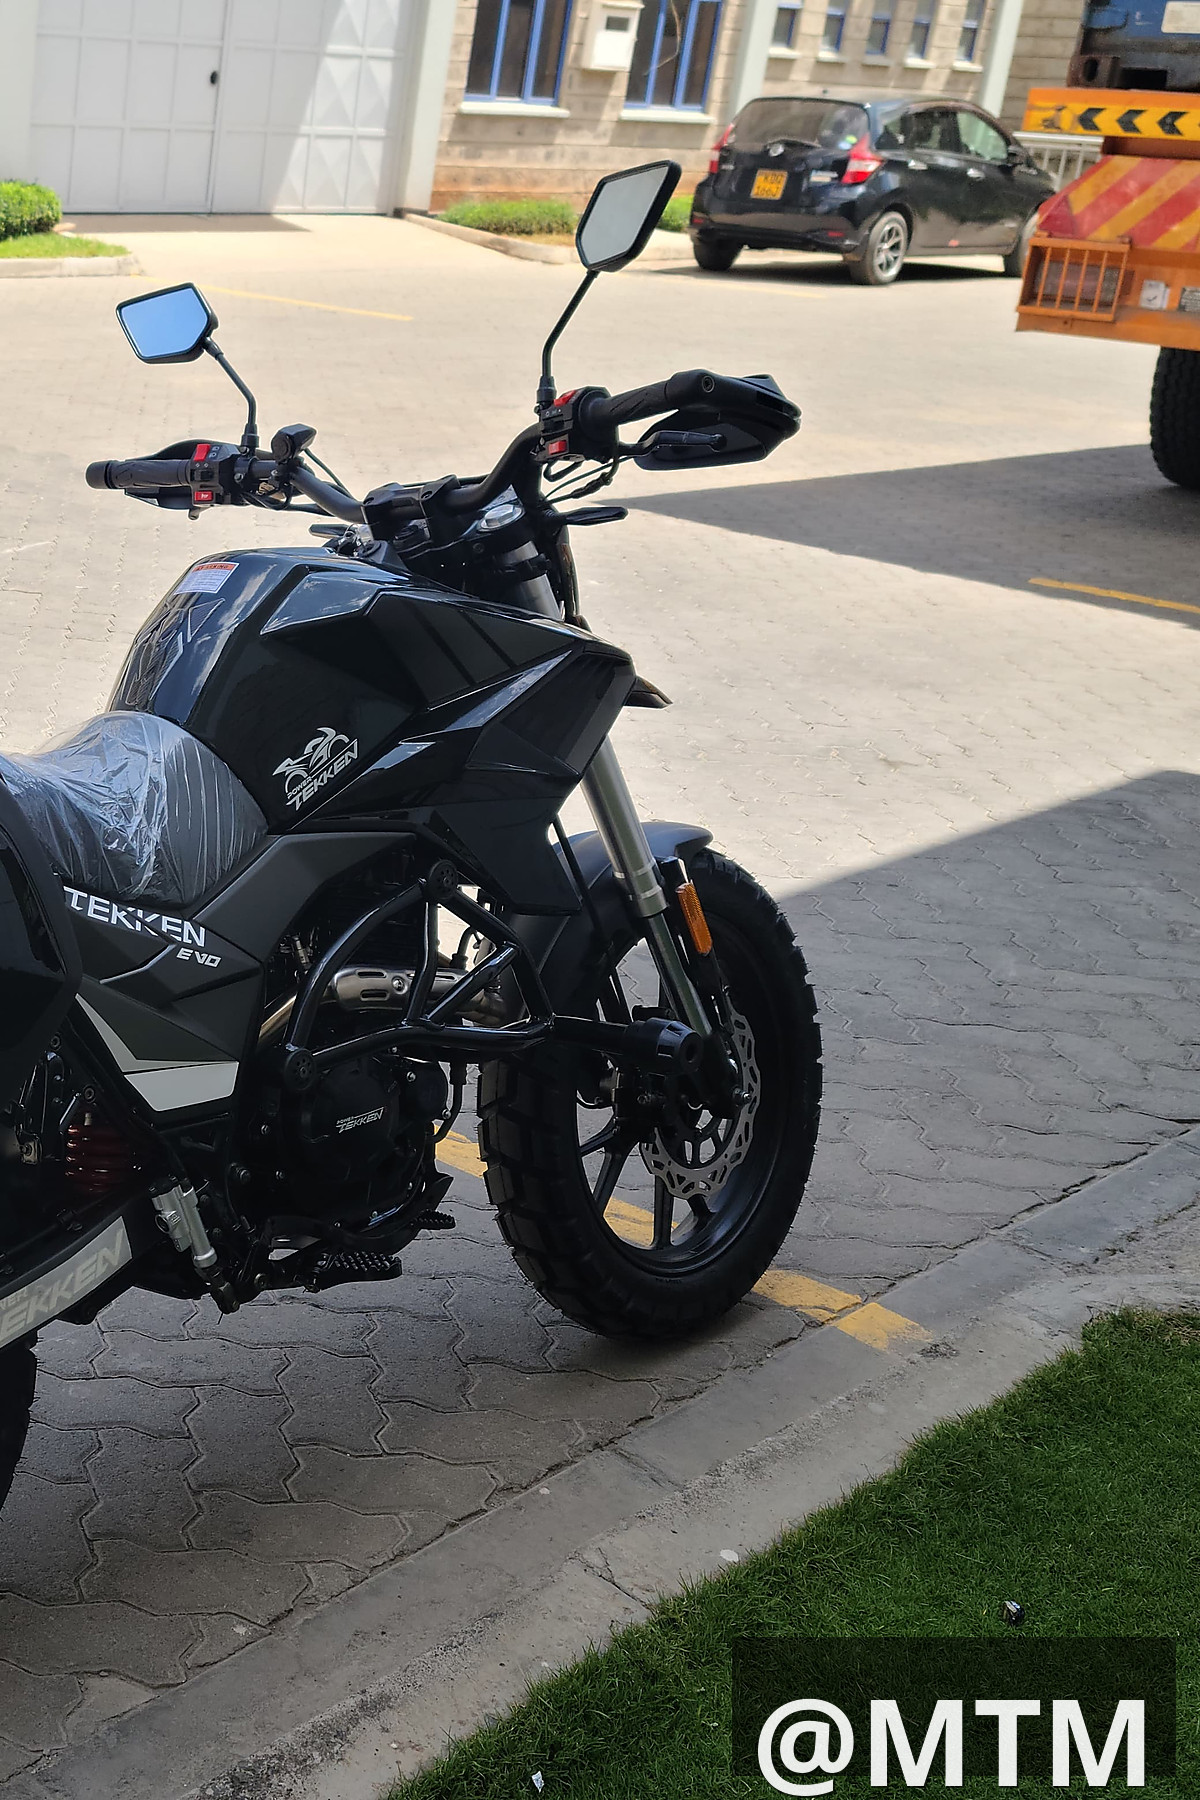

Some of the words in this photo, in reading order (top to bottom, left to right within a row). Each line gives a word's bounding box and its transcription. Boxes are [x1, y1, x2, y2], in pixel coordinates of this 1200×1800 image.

[286, 739, 358, 811] TEKKEN
[287, 776, 313, 800] POWER
[63, 885, 206, 948] TEKKEN
[176, 947, 222, 968] EVO
[335, 1106, 384, 1134] TEKKEN
